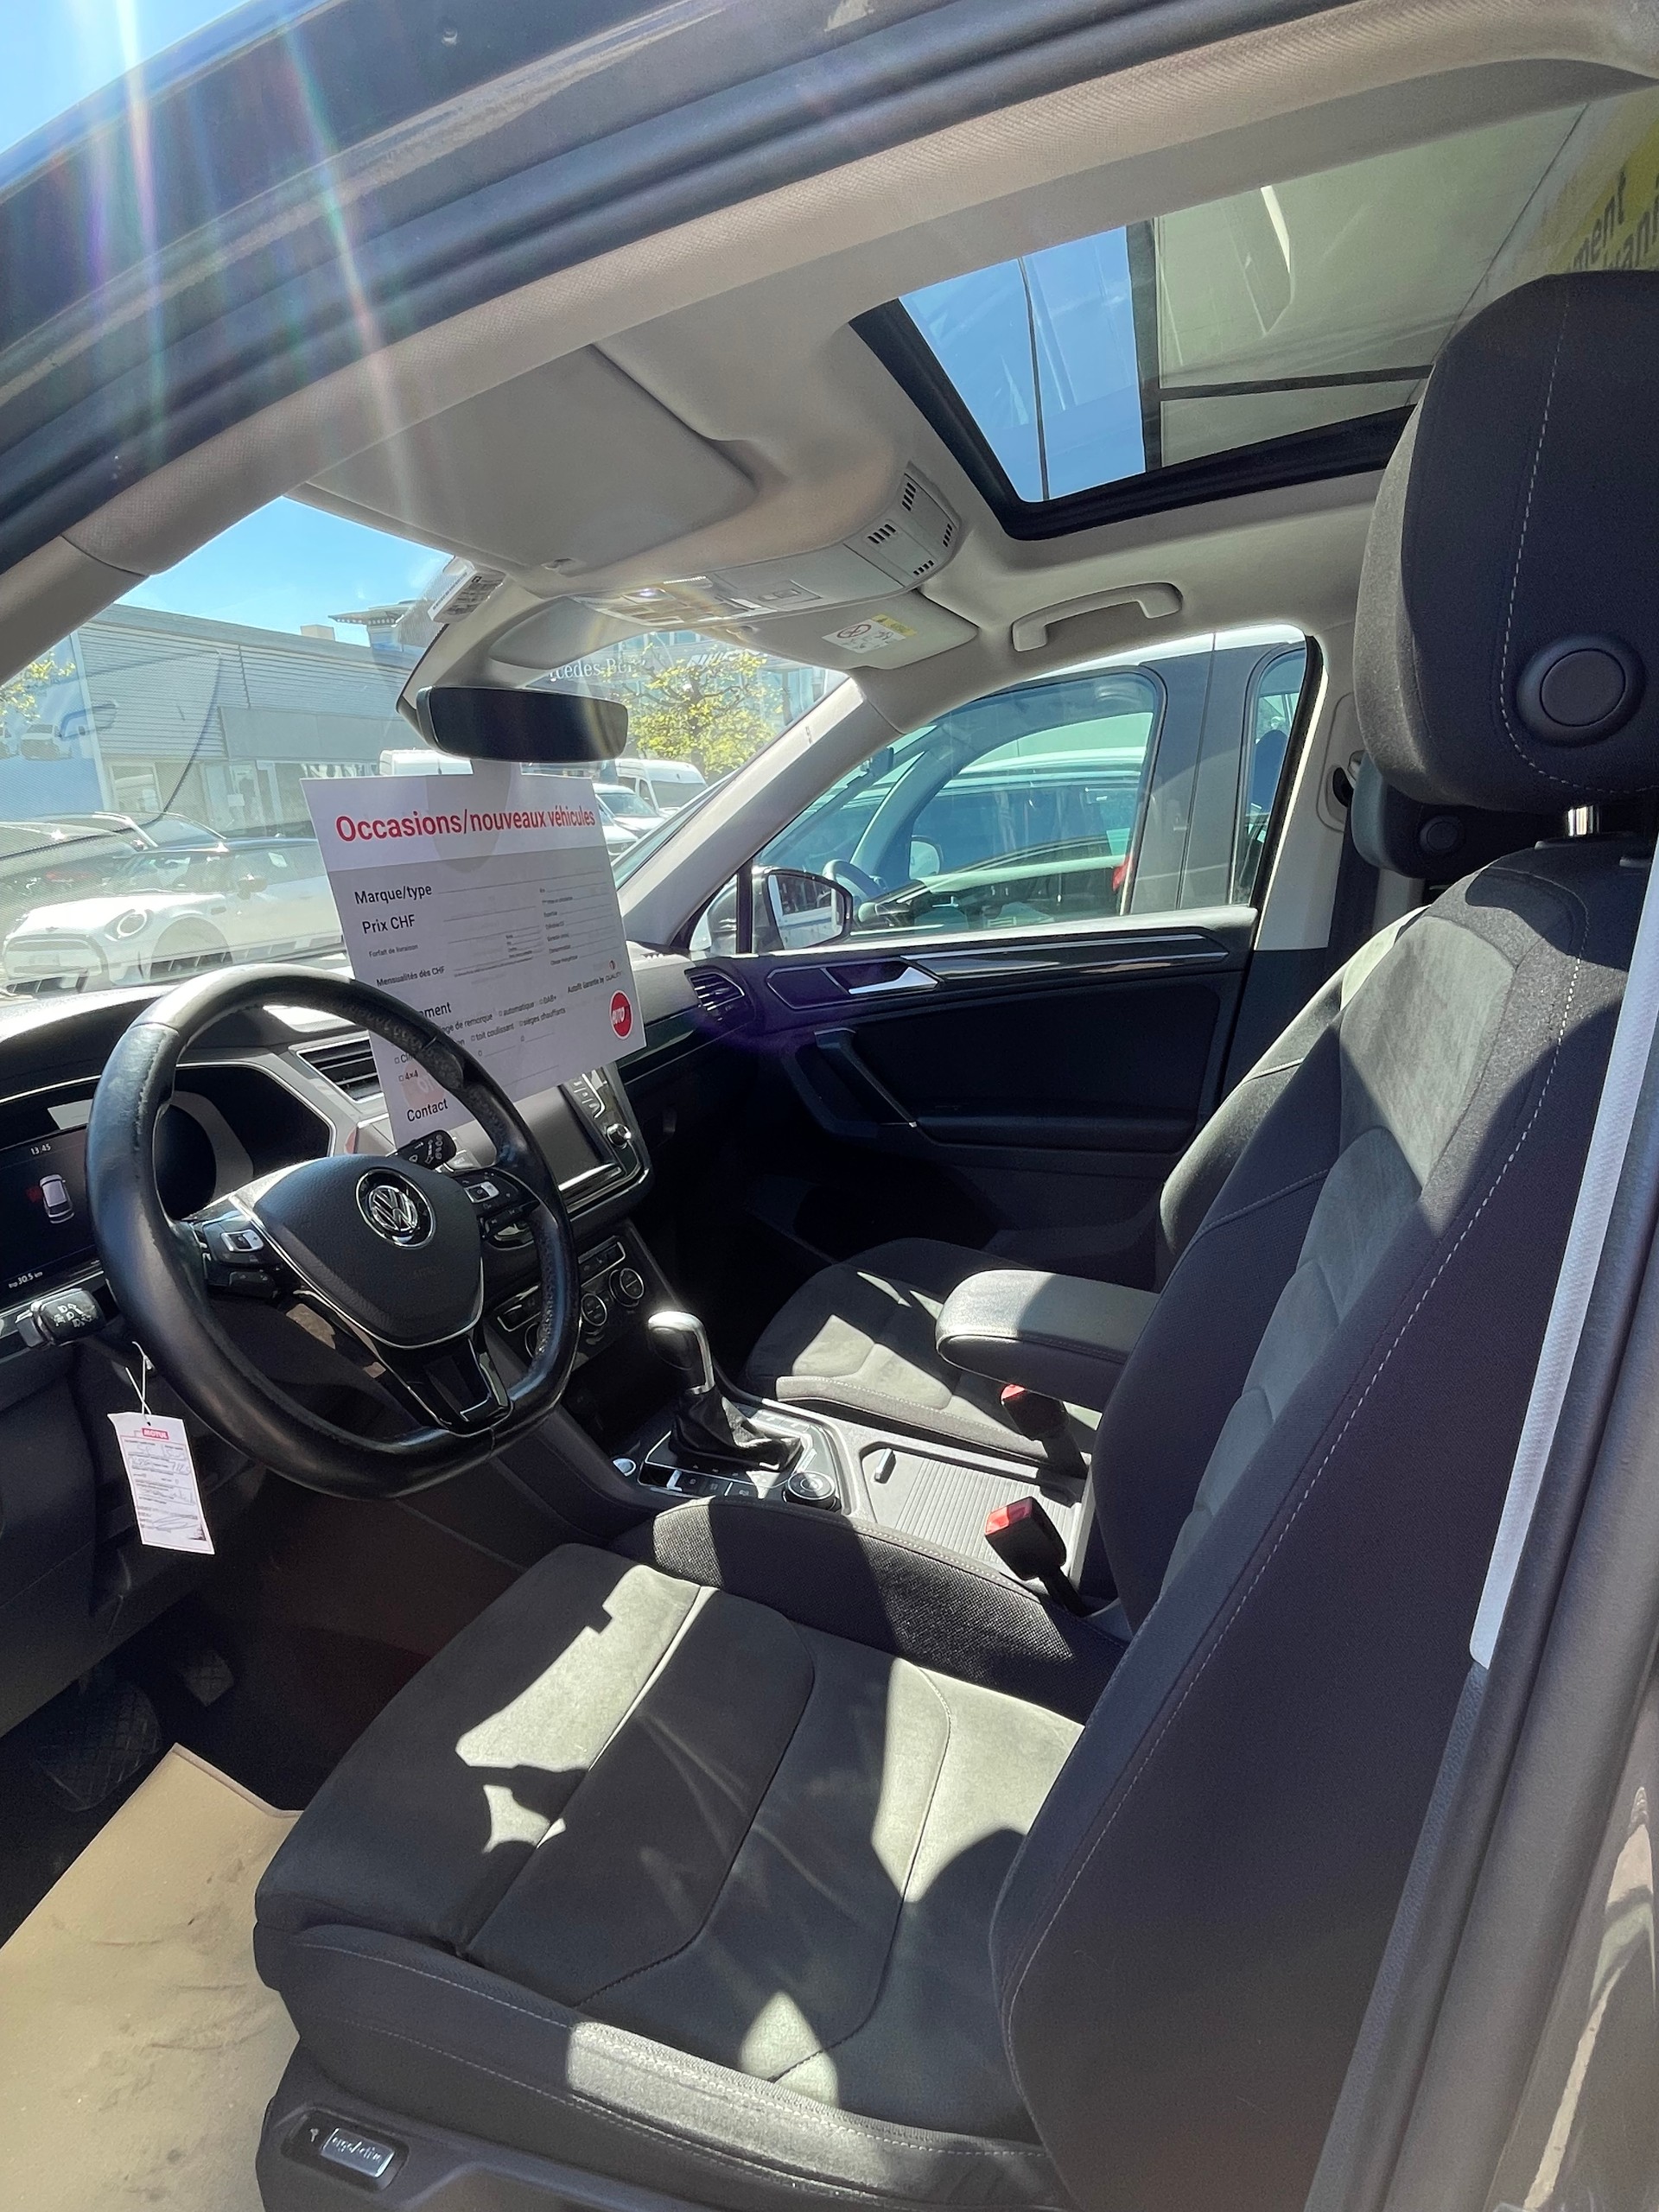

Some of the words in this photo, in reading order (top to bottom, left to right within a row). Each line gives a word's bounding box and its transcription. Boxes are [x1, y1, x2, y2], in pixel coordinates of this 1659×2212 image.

[336, 809, 546, 842] Occasions/nouveaux
[548, 805, 596, 827] véhicules
[354, 885, 433, 905] Marque/type
[362, 918, 388, 934] Prix
[390, 914, 415, 930] CHF
[376, 971, 418, 987] Mensualités
[419, 968, 431, 978] dès
[431, 965, 445, 976] CHF
[454, 1020, 464, 1030] de
[407, 1098, 448, 1122] Contact
[143, 1429, 168, 1440] MOTUL
